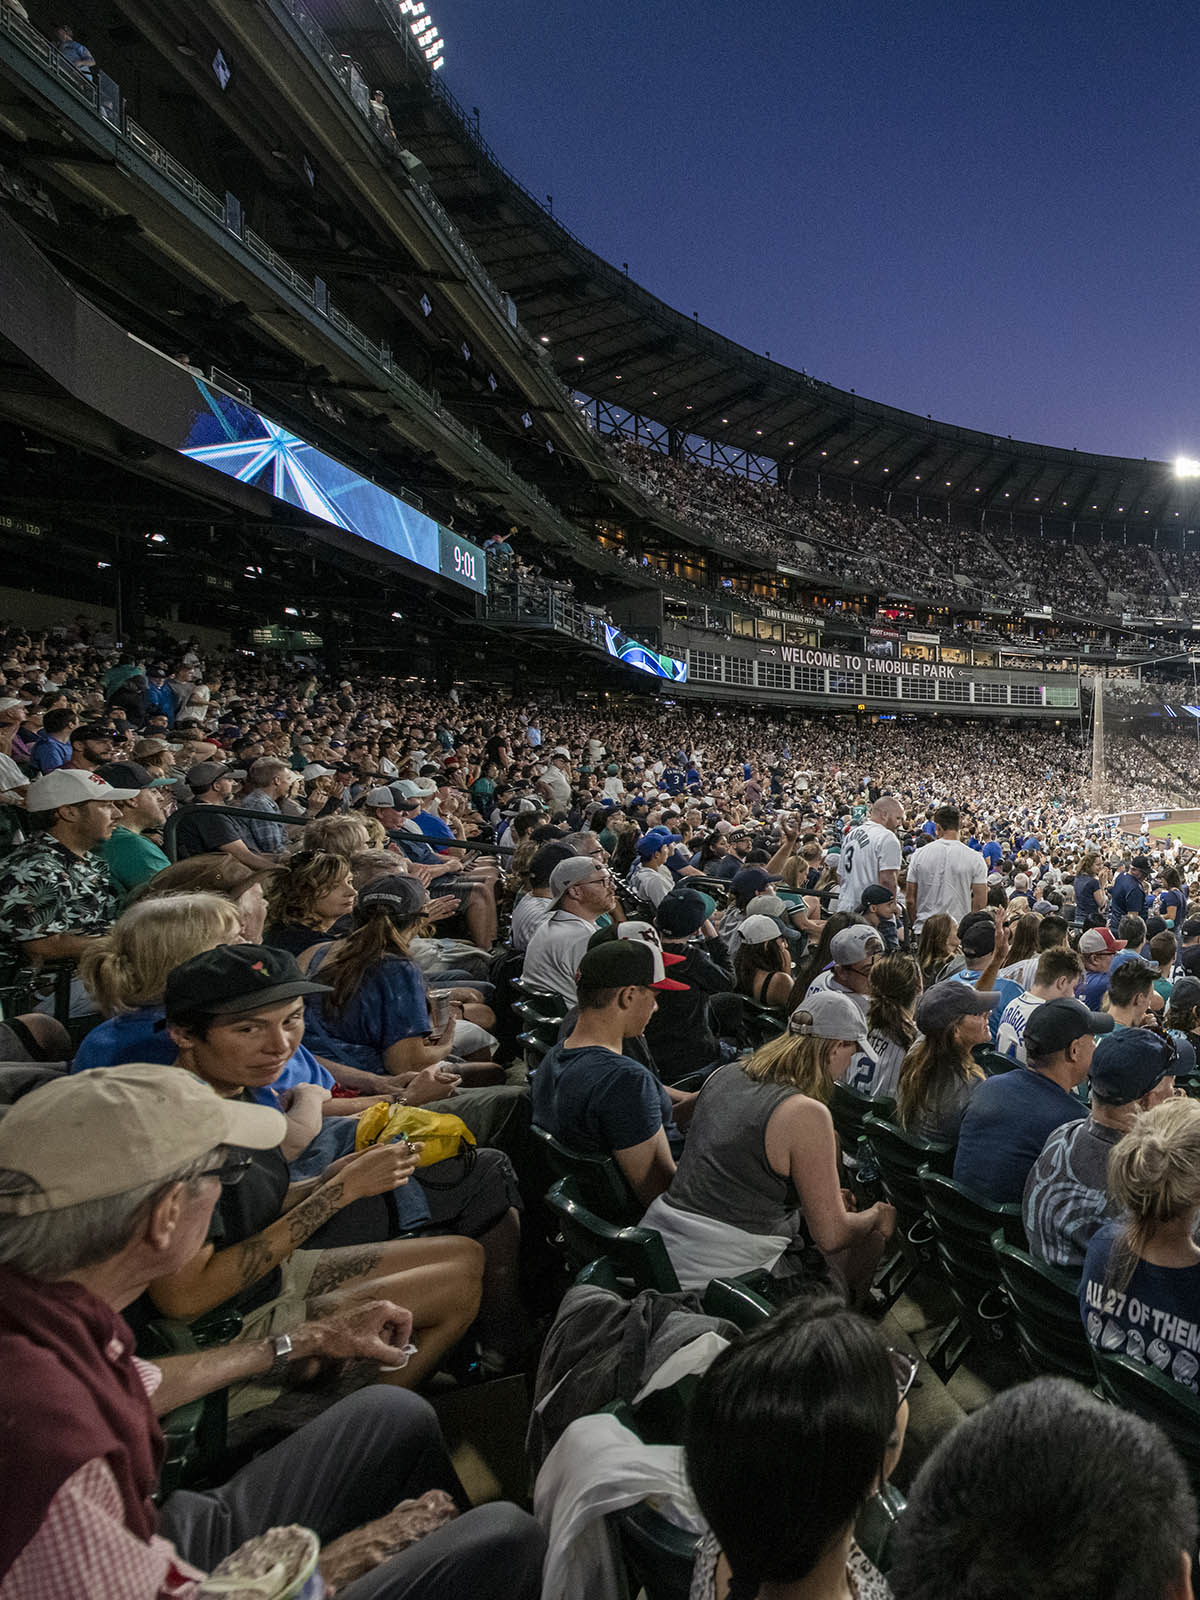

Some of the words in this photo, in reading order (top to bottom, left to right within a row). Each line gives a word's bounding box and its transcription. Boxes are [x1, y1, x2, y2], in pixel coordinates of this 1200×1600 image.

[453, 543, 477, 581] 9:01
[780, 646, 841, 668] WELCOME
[844, 654, 861, 670] TO
[865, 657, 920, 677] T-MOBILE
[922, 663, 955, 679] PARK
[855, 1056, 876, 1096] 2
[1085, 1279, 1104, 1309] ALL
[1103, 1288, 1127, 1318] 27
[1128, 1297, 1151, 1328] OF
